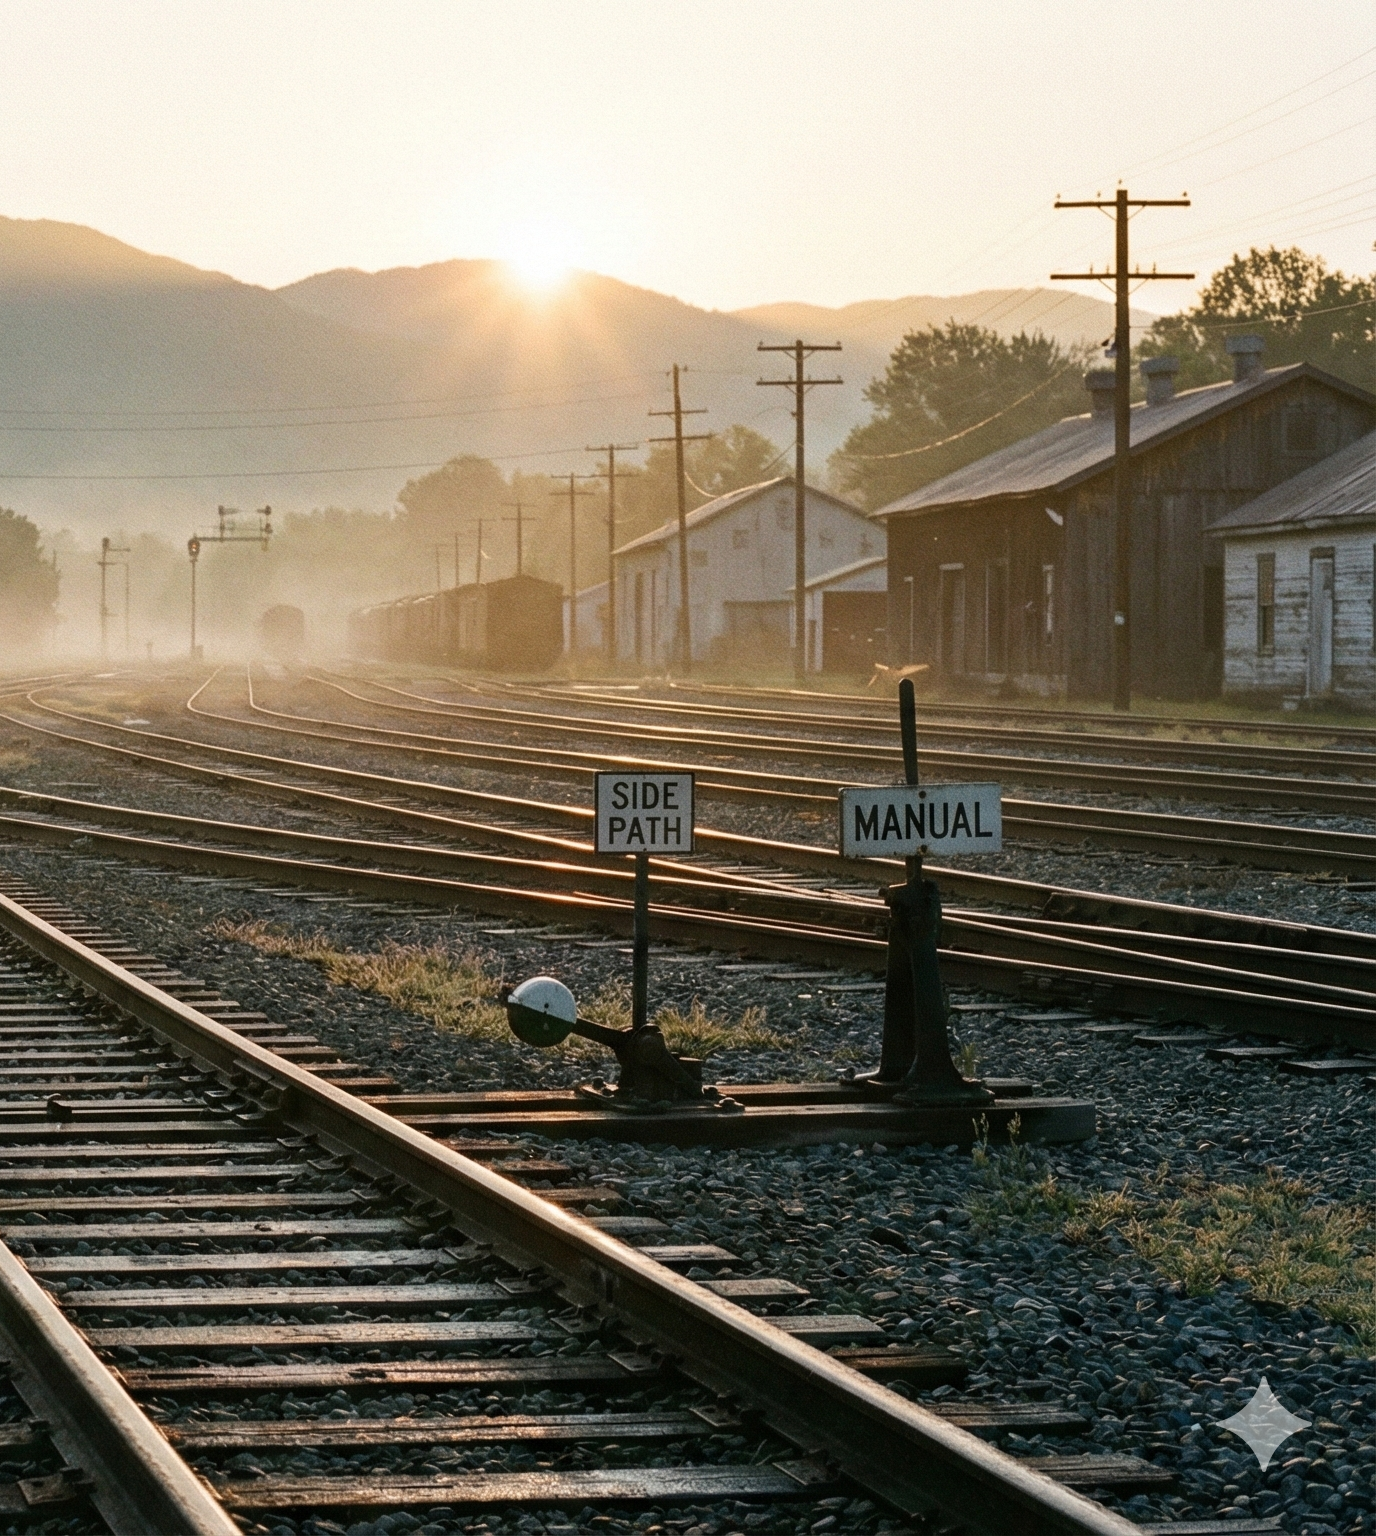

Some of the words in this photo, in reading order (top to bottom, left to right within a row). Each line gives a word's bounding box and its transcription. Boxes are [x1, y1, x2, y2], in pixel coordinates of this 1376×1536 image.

[612, 782, 679, 810] SIDE
[608, 816, 681, 845] PATH
[854, 801, 993, 841] MANUAL
